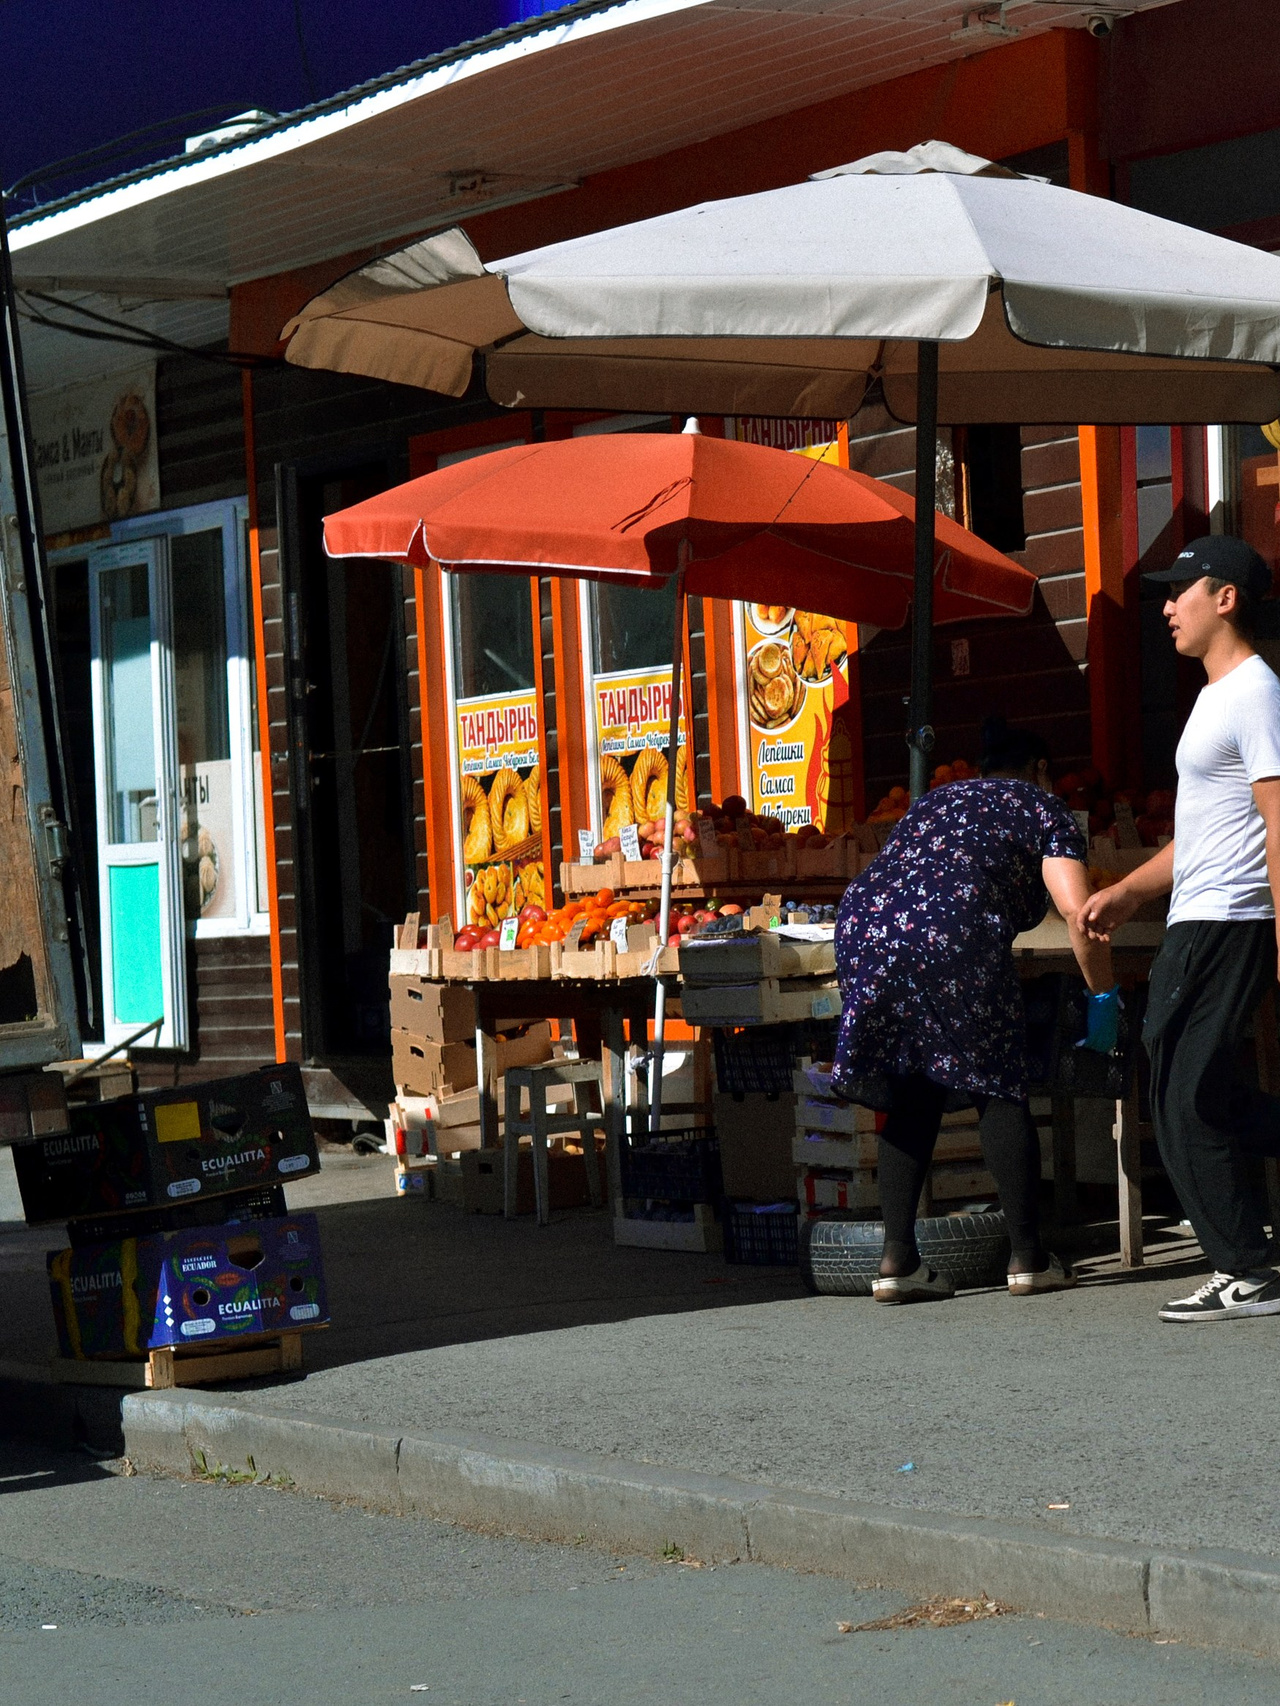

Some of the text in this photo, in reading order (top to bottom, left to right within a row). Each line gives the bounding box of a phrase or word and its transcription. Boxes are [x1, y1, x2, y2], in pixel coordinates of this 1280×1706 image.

[646, 733, 670, 748] Чебурек
[758, 740, 804, 767] Лепёшки
[760, 772, 794, 796] Самса
[43, 1133, 100, 1157] ECUALITTA
[201, 1148, 266, 1172] ECUALITTA
[182, 1260, 217, 1273] ECUADOR
[71, 1271, 123, 1294] CUALITTA
[218, 1297, 281, 1316] ECUALITTA
